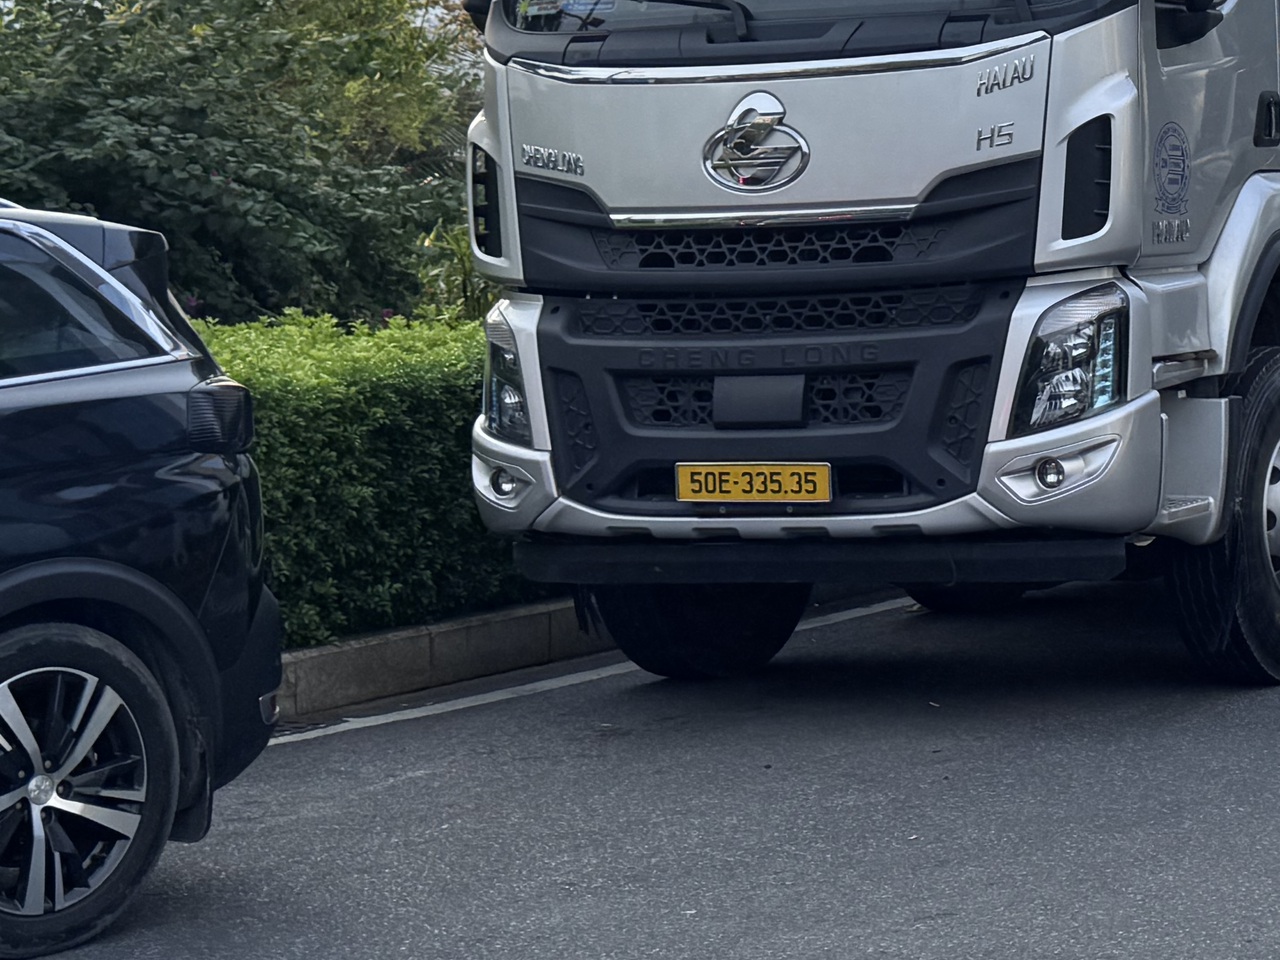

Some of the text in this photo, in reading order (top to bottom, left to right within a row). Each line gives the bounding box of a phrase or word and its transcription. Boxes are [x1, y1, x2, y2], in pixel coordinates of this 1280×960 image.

[522, 143, 585, 176] CHENGLONG
[638, 342, 880, 369] CHENG LONG
[689, 471, 817, 495] 50E-335.35
